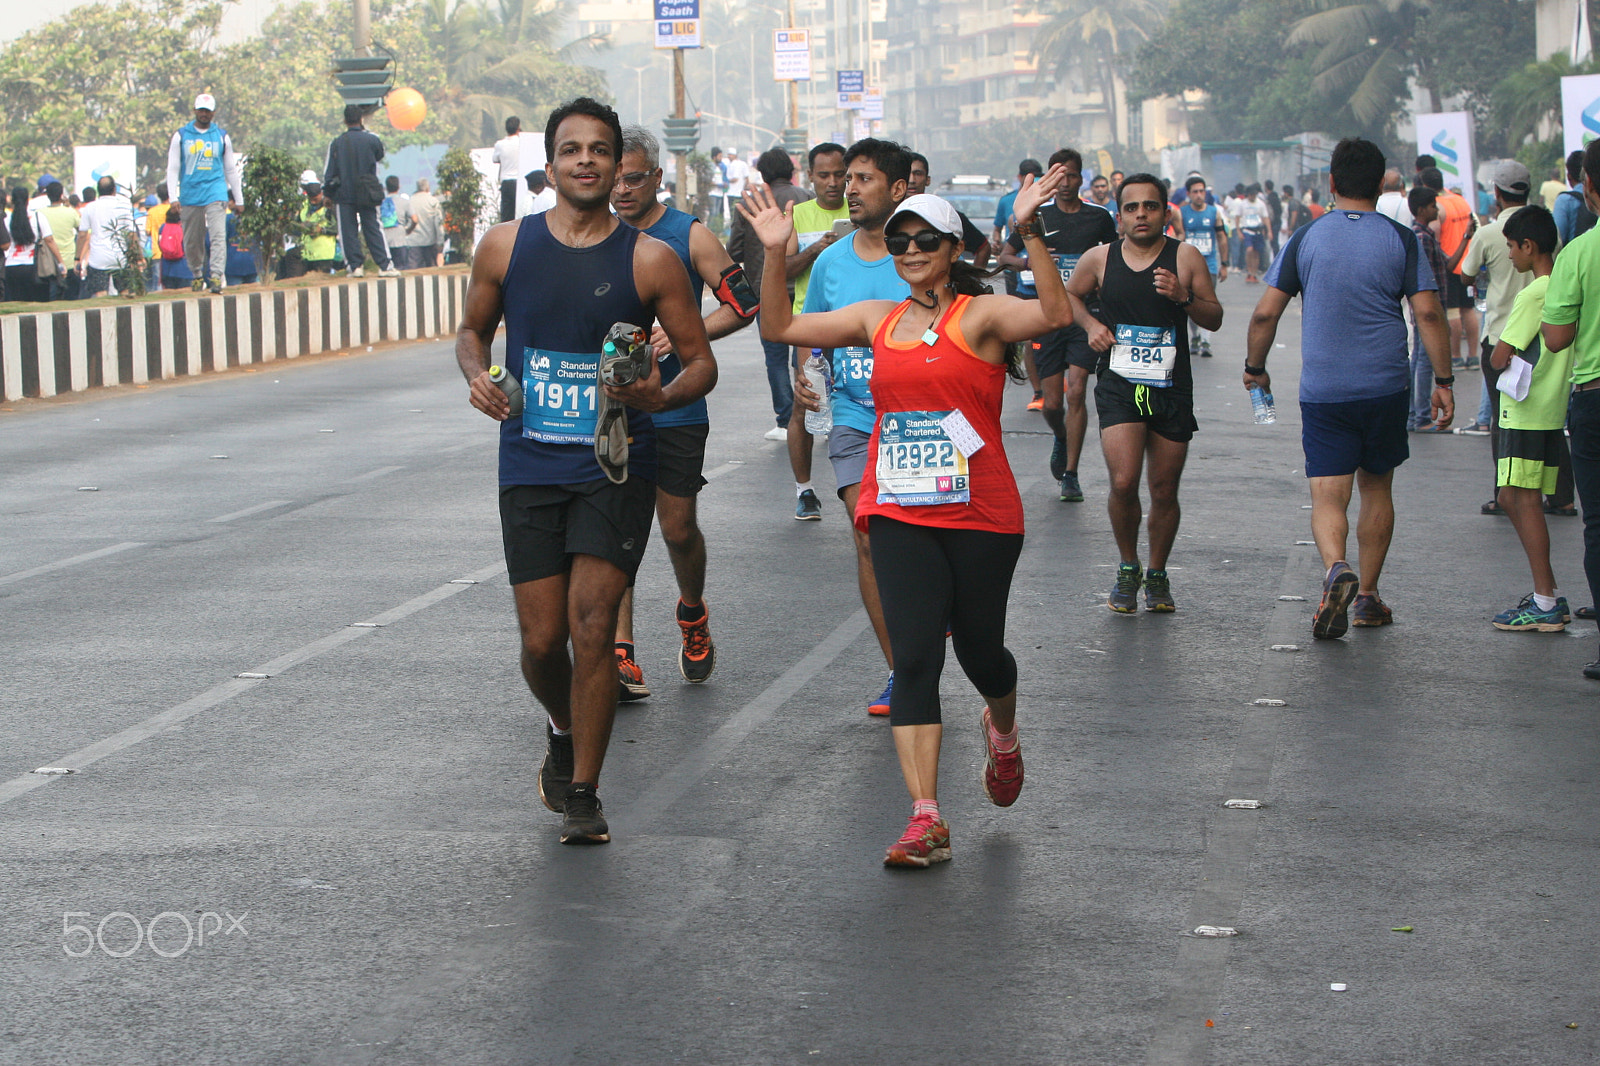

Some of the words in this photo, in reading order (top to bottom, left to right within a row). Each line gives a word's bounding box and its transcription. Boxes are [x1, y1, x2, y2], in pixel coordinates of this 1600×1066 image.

[660, 6, 693, 16] Saath
[675, 22, 695, 34] LIC
[1131, 347, 1163, 364] 824
[560, 360, 597, 370] Standard
[850, 358, 874, 379] 33
[557, 369, 597, 379] Chartered
[534, 381, 596, 411] 1911
[906, 419, 940, 428] Standard
[528, 431, 542, 439] TATA
[543, 434, 584, 443] CONSULTANCY
[904, 428, 941, 437] Chartered
[886, 442, 954, 470] 12922
[940, 480, 949, 489] W
[955, 477, 966, 490] B
[935, 493, 962, 501] SERVICES
